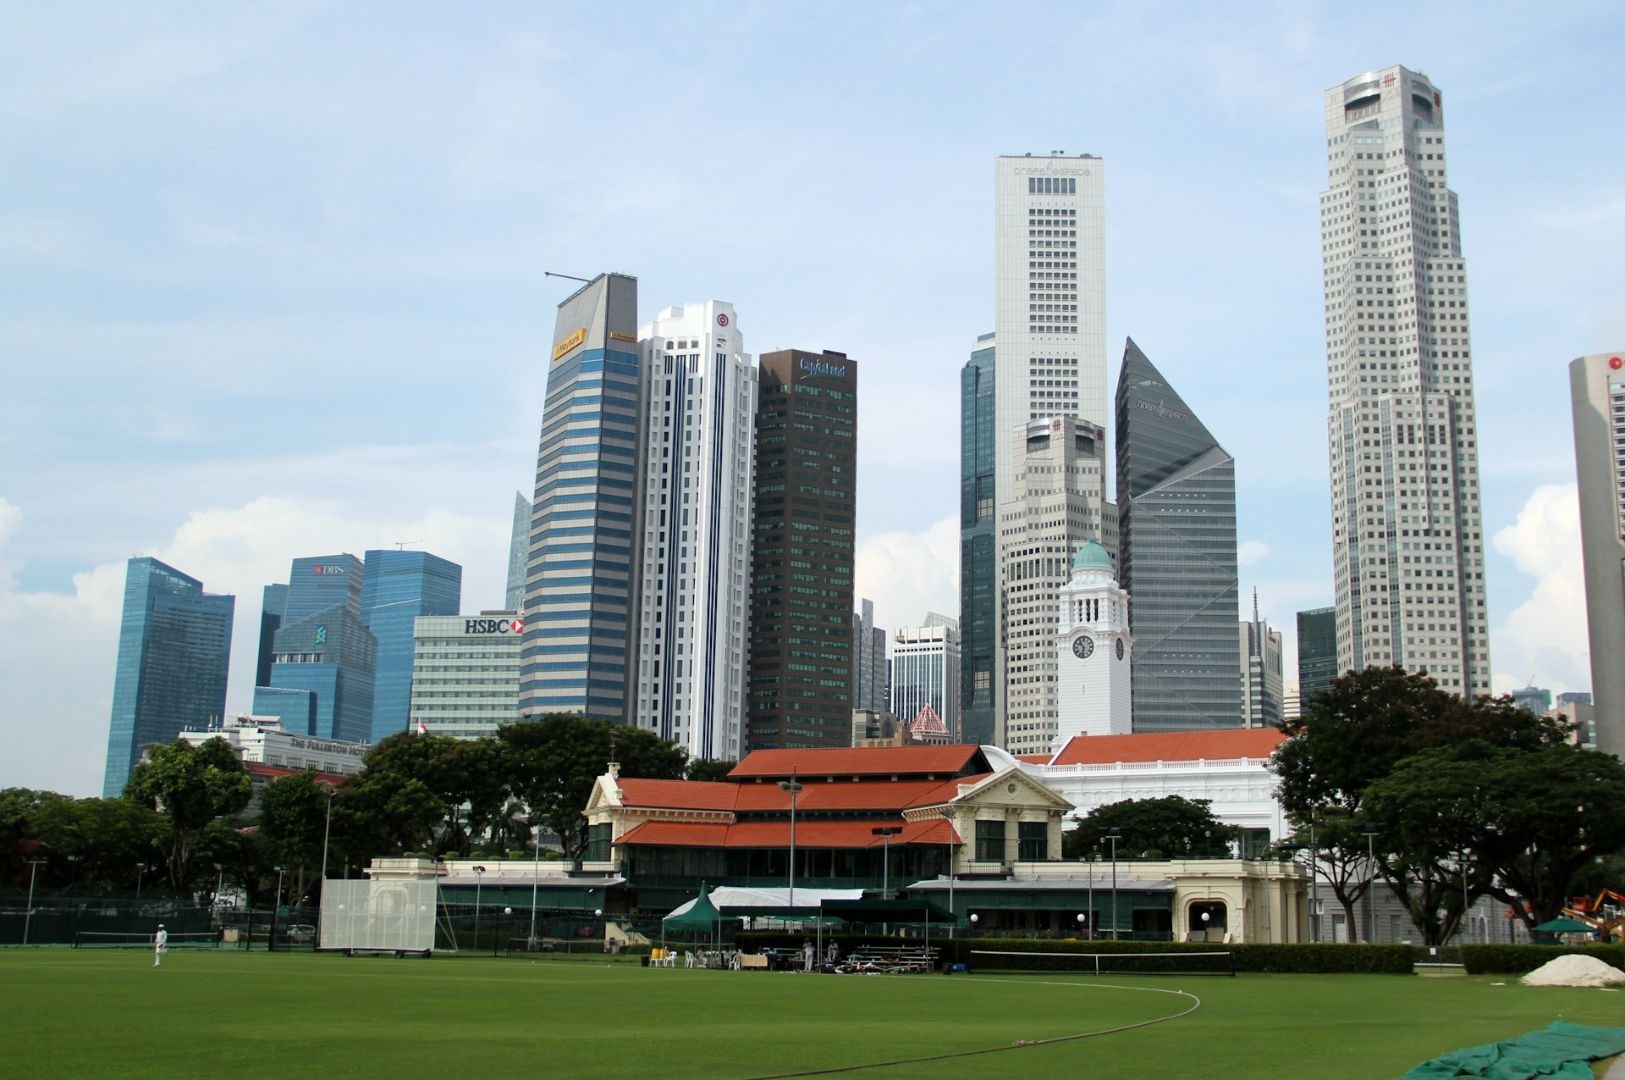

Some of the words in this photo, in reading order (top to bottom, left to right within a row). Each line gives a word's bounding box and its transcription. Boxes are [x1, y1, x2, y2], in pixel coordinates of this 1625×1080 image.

[323, 565, 344, 575] DBS
[465, 619, 509, 634] HSBC
[291, 738, 305, 749] THE
[307, 740, 347, 754] FULLERTON
[349, 747, 367, 756] HOT
